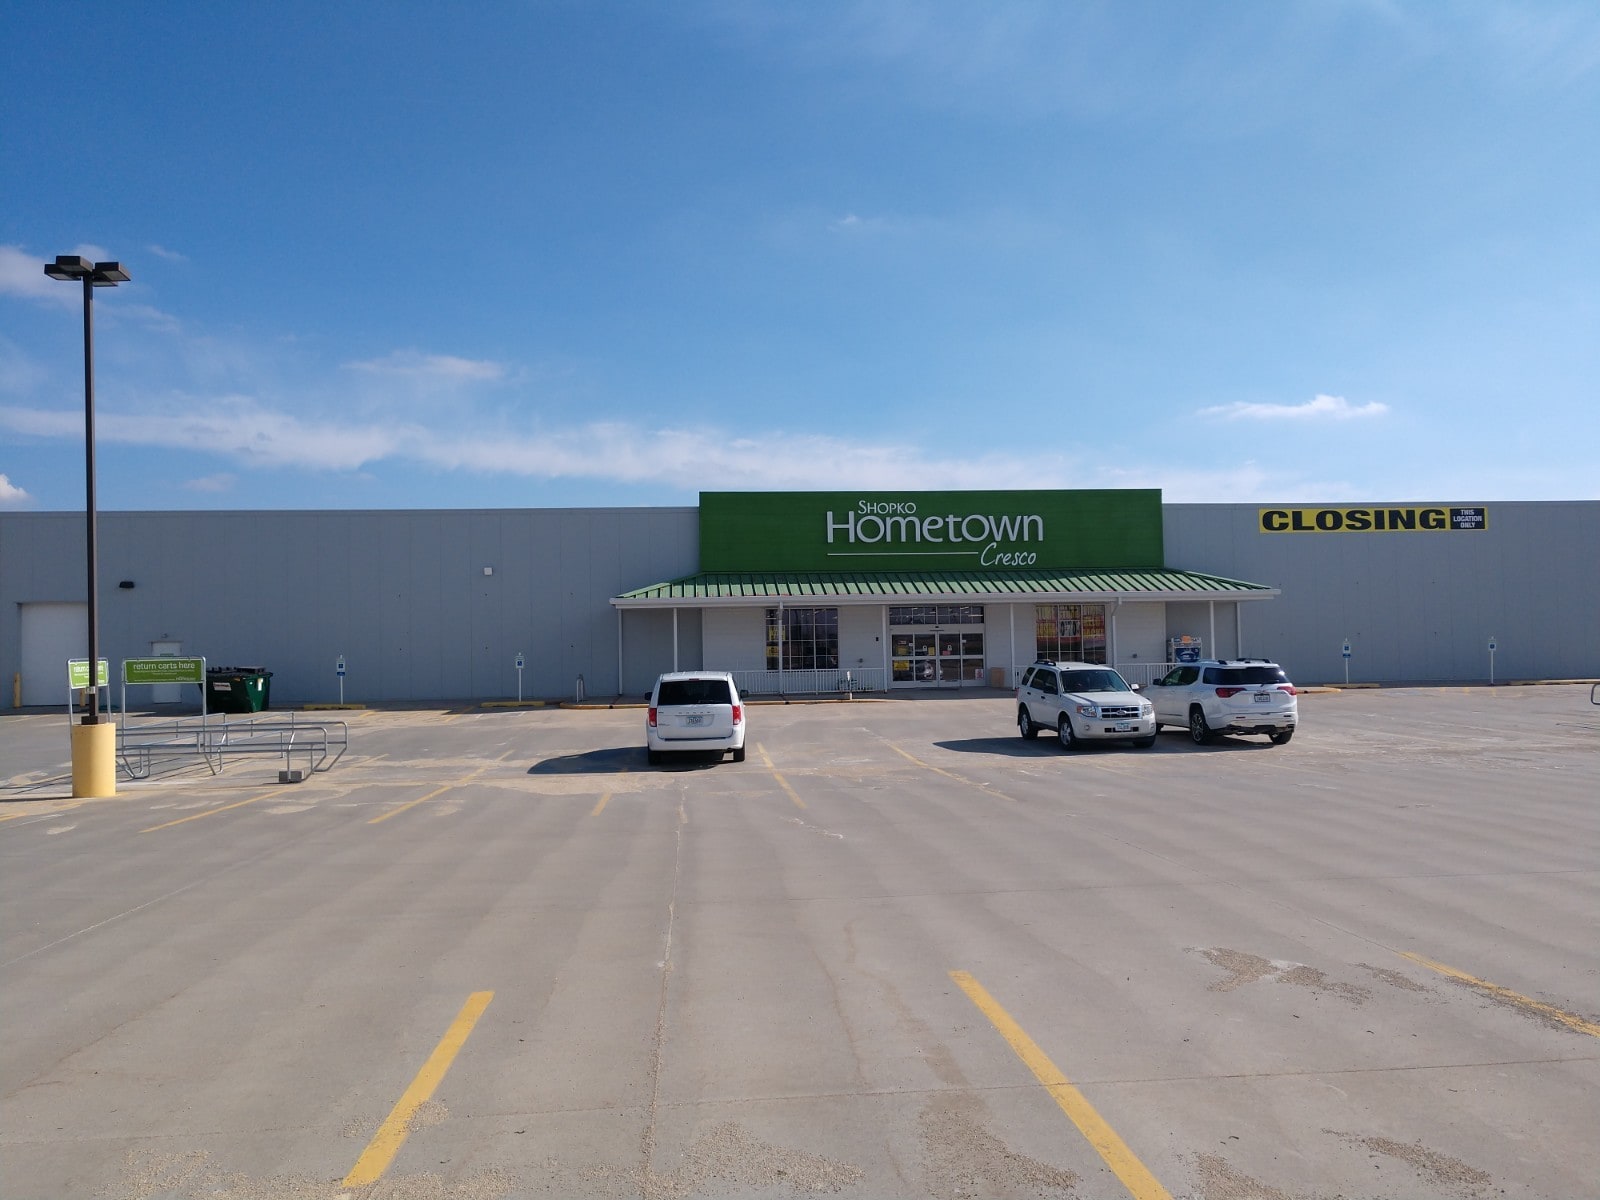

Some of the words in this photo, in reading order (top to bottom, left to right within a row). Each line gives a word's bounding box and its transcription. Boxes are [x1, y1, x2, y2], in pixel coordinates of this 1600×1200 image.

[857, 500, 917, 514] SHOPKO
[826, 511, 1044, 543] Hometown
[1262, 509, 1446, 531] CLOSING
[980, 542, 1037, 566] Cresco
[178, 661, 195, 669] here
